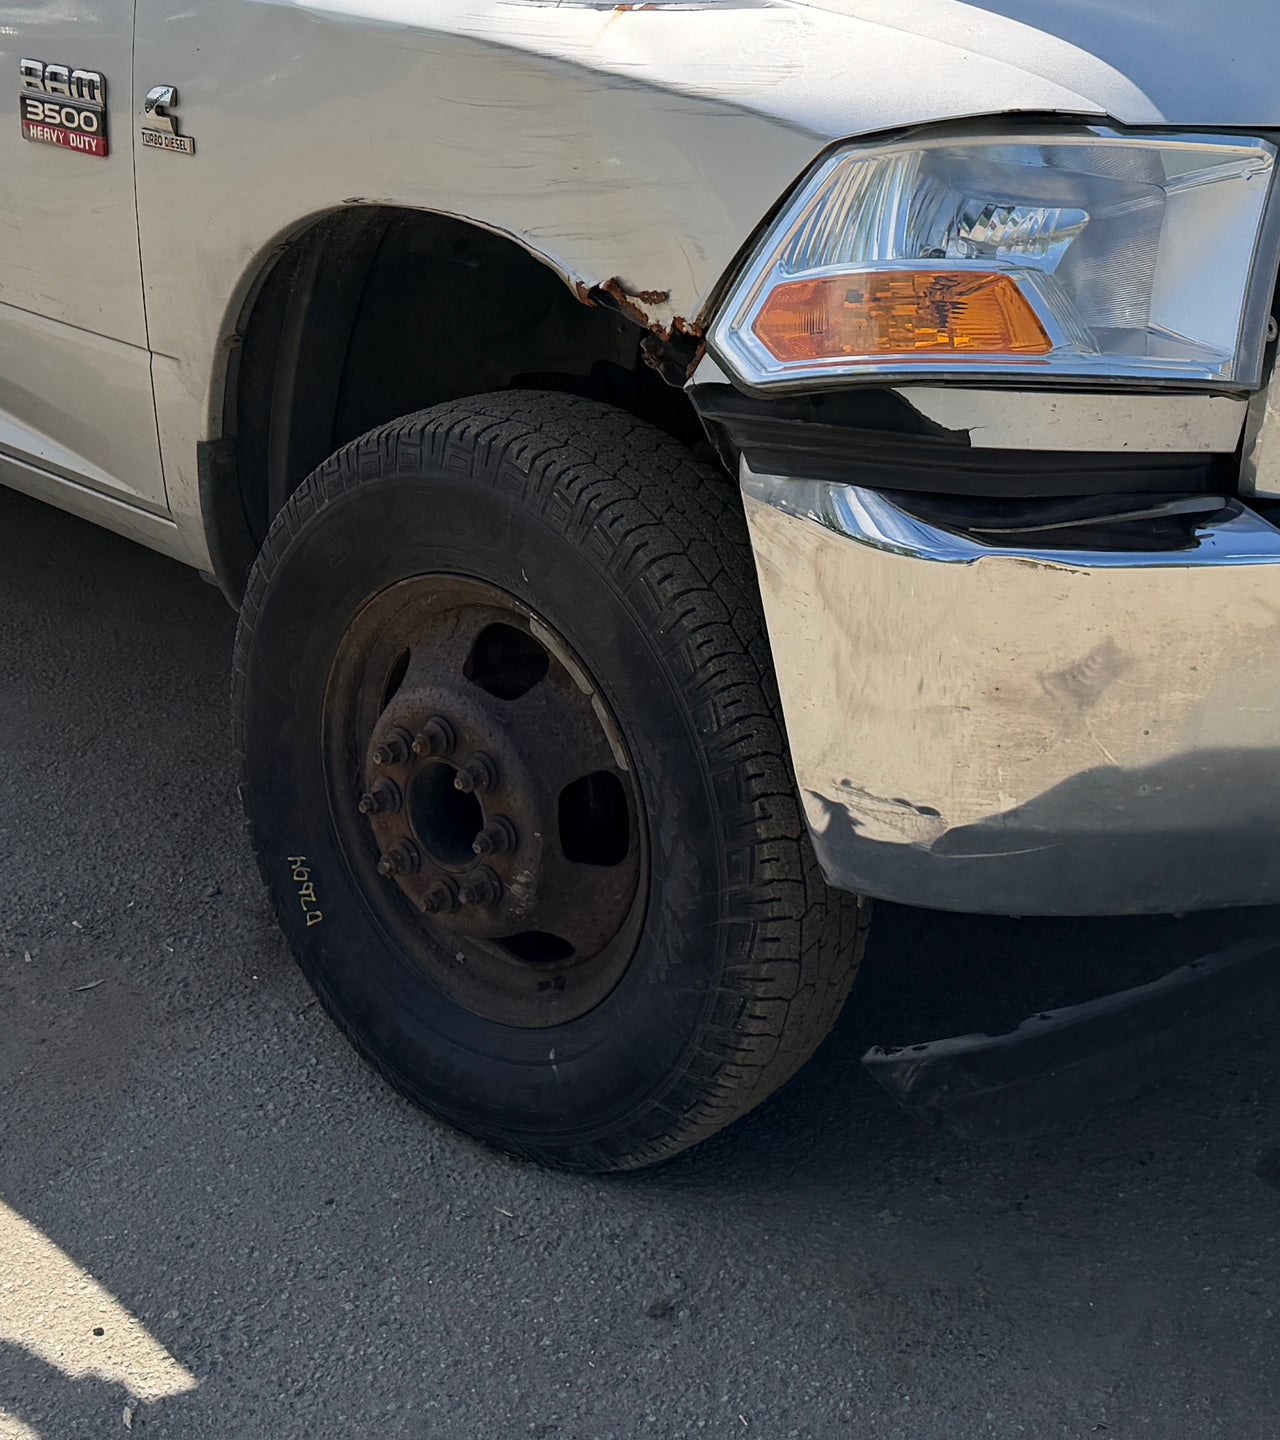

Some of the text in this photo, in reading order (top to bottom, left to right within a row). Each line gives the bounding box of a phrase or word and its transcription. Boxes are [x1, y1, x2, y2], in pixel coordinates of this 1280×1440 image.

[20, 59, 105, 106] RAM
[25, 99, 98, 132] 3500
[30, 124, 98, 152] HEAVY DUTY
[141, 132, 187, 152] TURBO DIESEL
[287, 856, 323, 926] D2604
